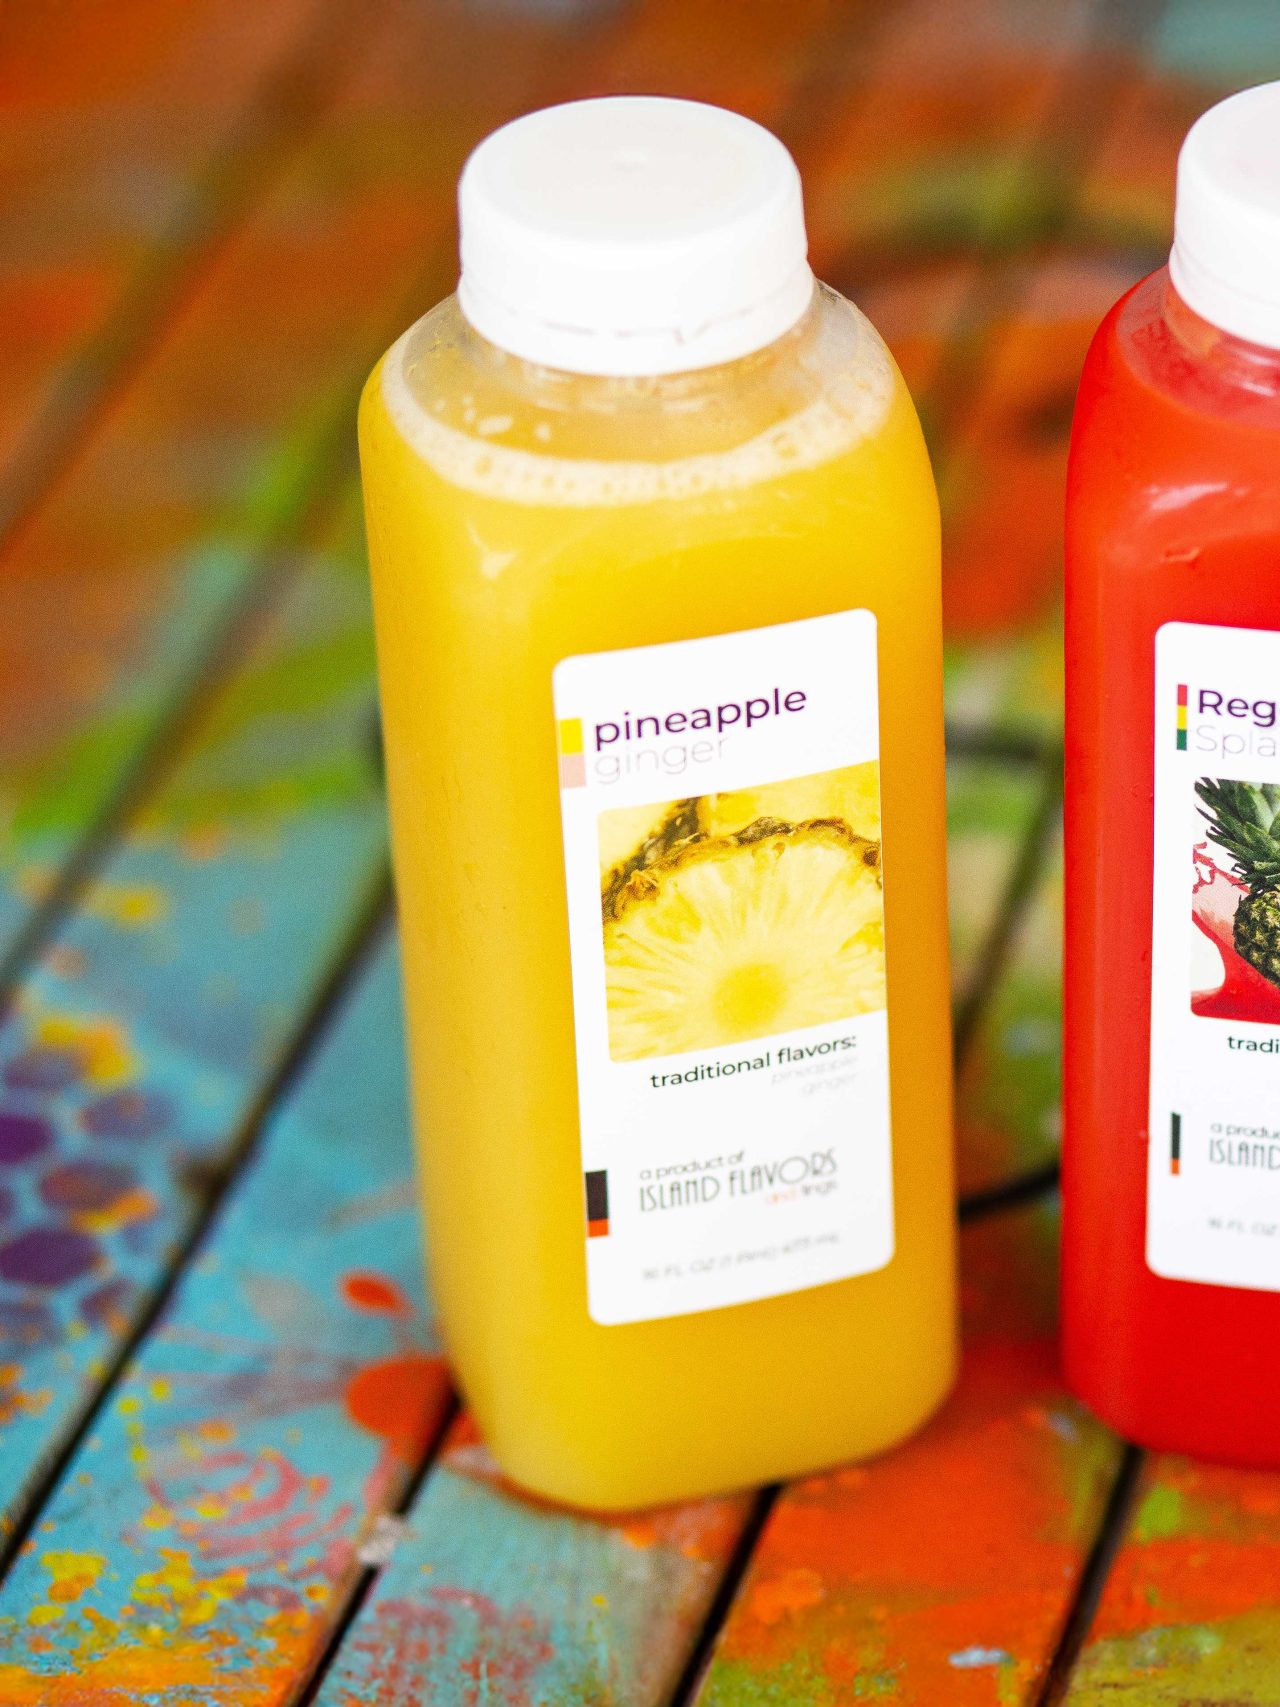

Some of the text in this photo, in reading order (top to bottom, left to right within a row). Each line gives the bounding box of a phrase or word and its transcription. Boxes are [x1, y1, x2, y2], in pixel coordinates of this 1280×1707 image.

[595, 688, 807, 752] pineapple
[595, 737, 730, 785] ginger
[651, 1036, 857, 1088] traditional flavors:
[1210, 1123, 1222, 1134] a
[639, 1148, 838, 1213] ISLAND FLAVORS
[640, 1149, 745, 1181] a product of
